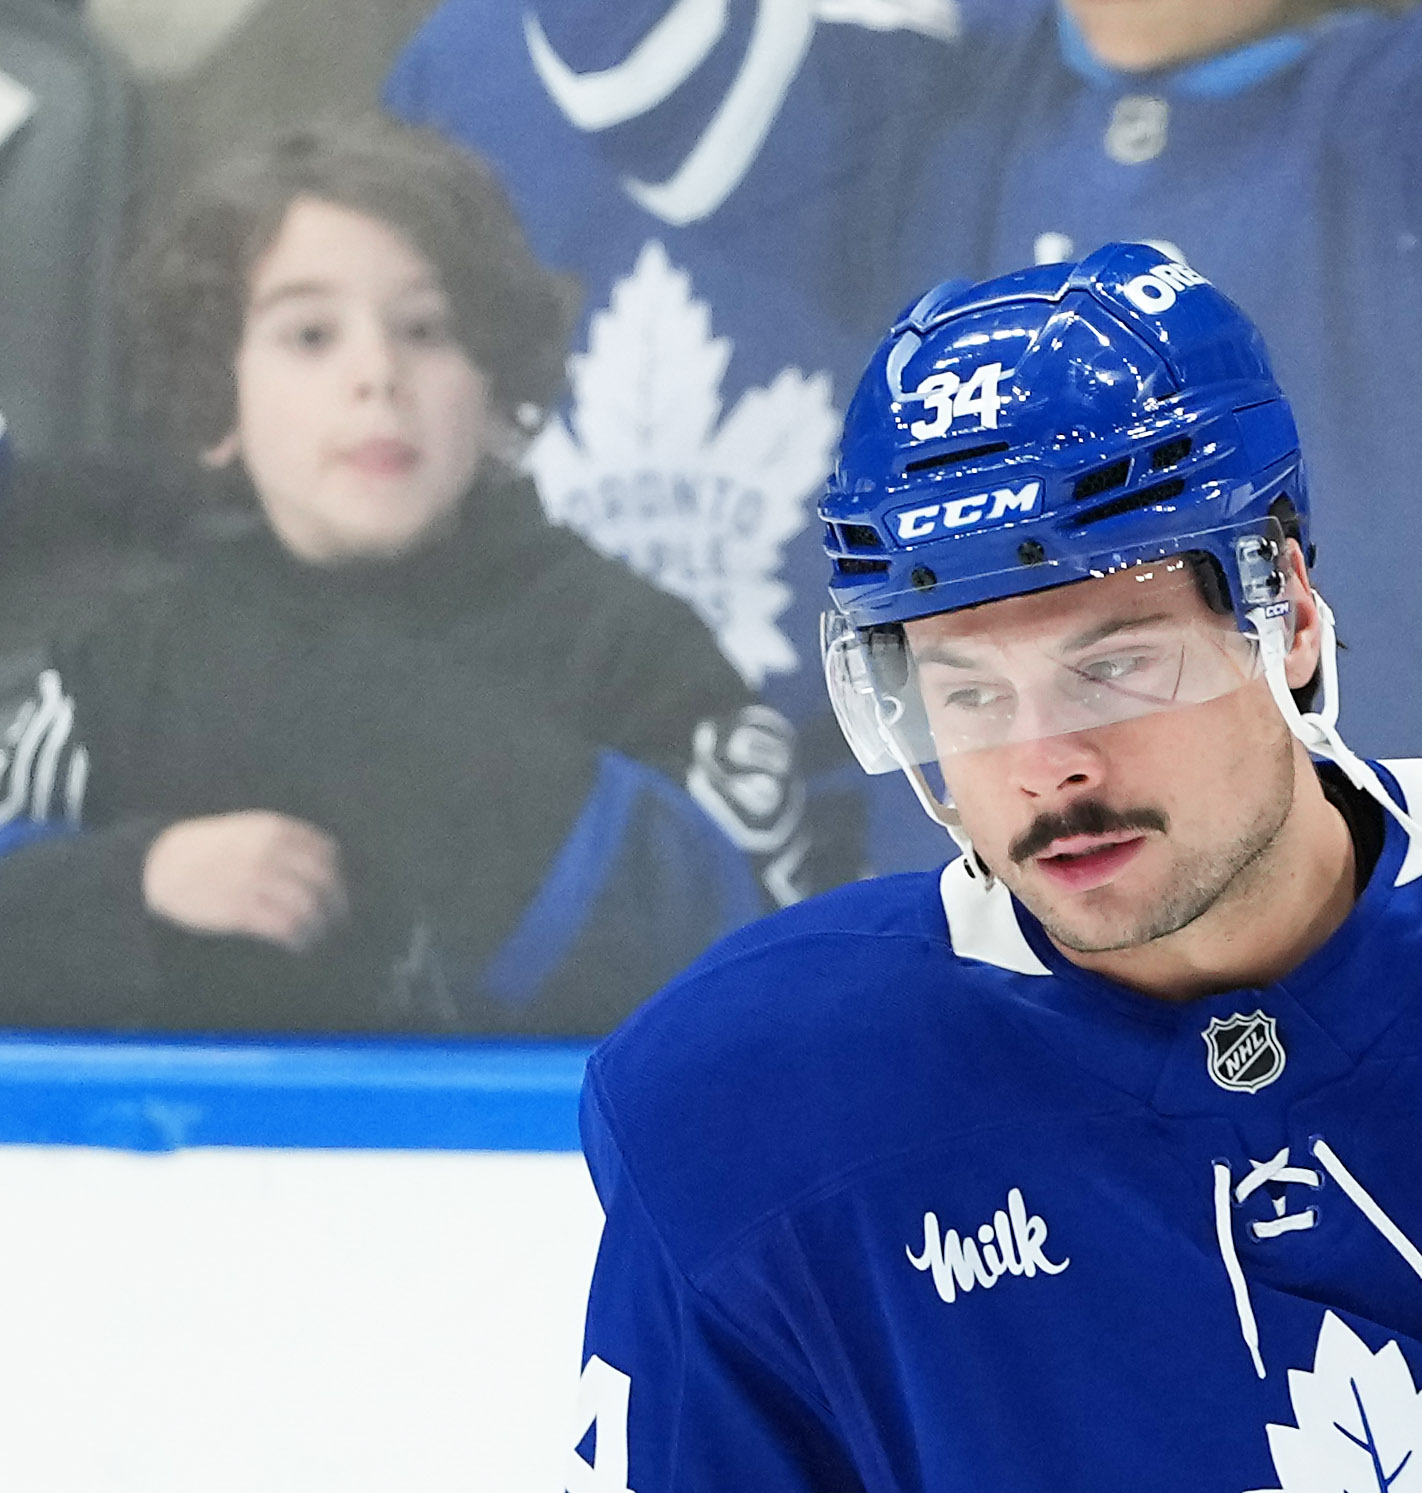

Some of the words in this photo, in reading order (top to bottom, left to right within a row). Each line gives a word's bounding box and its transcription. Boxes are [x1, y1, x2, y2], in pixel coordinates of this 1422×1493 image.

[1123, 262, 1212, 315] ORE
[911, 362, 1002, 441] 34
[556, 468, 766, 542] ORONTO
[897, 482, 1040, 540] CCM
[1225, 1031, 1265, 1078] NHL
[906, 1187, 1070, 1304] Milk
